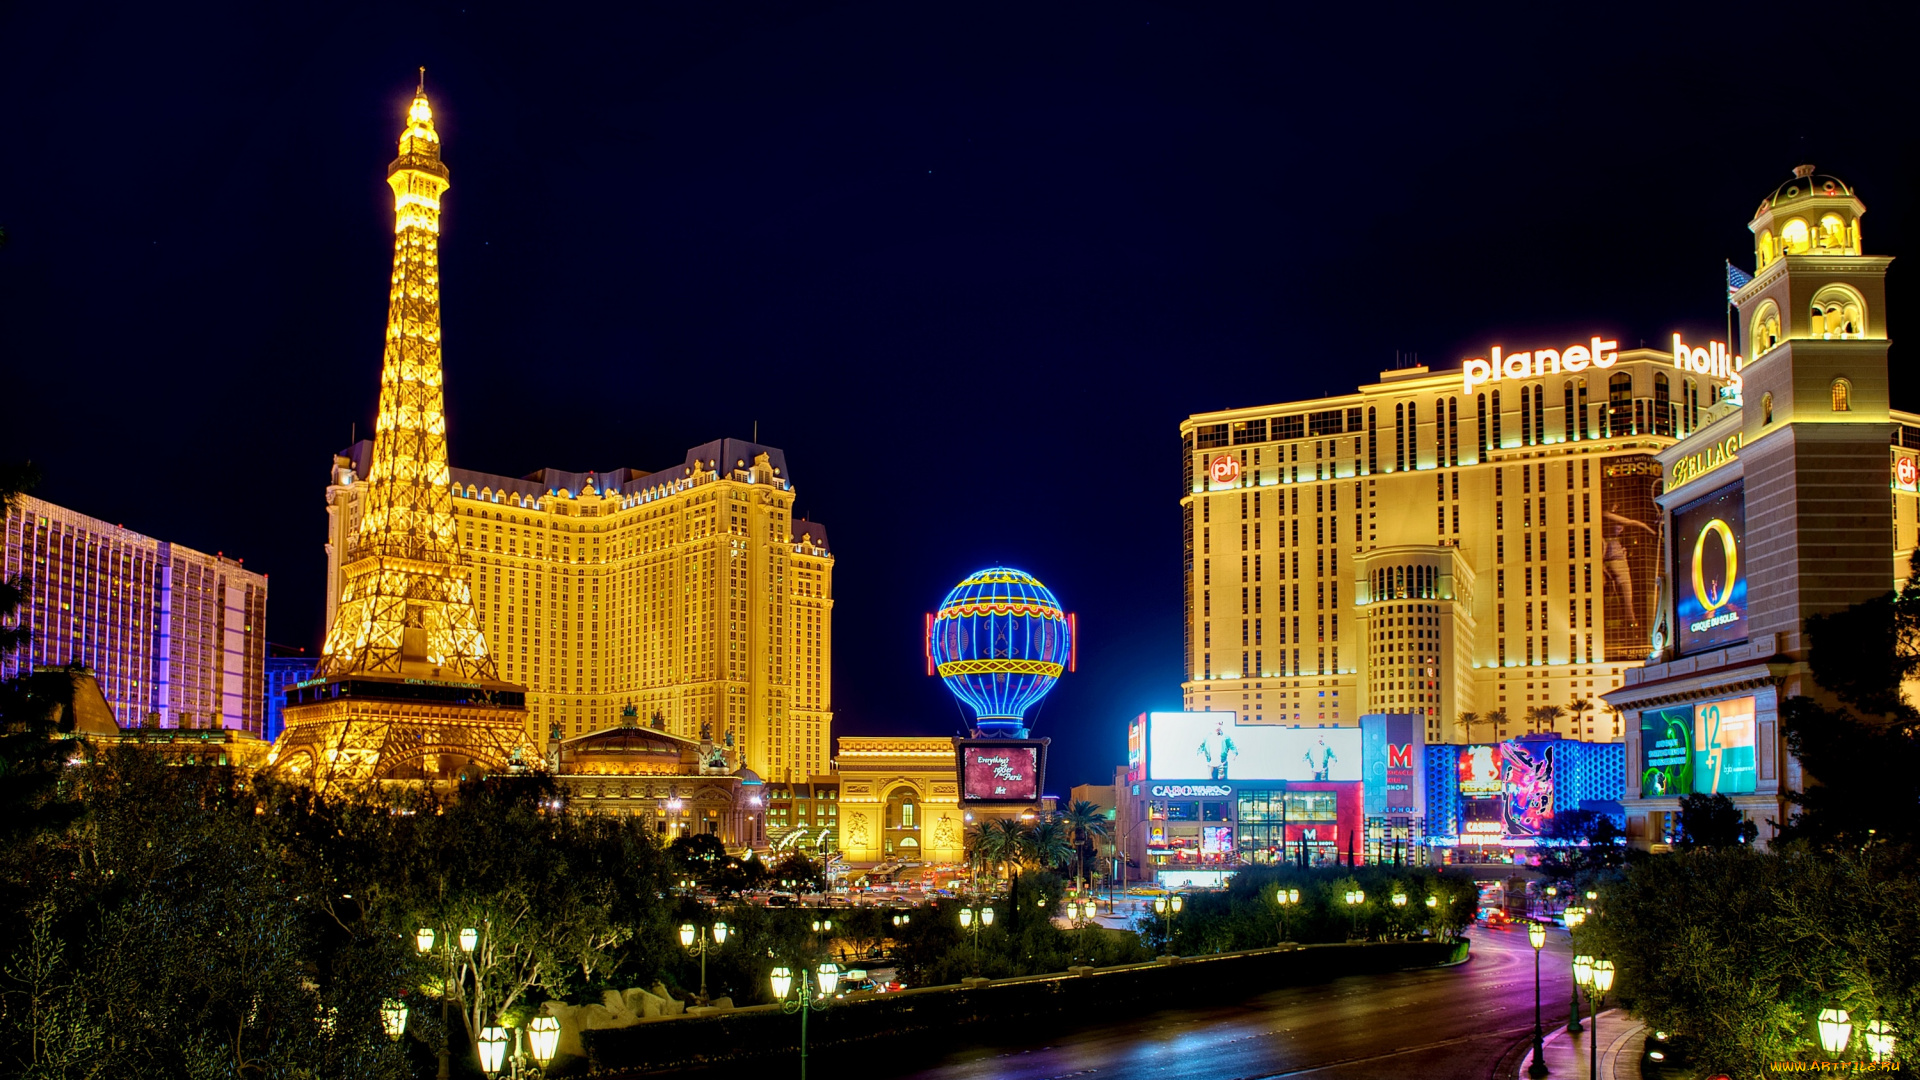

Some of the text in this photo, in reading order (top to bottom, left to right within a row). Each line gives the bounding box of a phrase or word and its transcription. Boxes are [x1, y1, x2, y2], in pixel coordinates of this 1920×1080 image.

[1463, 336, 1618, 394] planet
[1214, 456, 1239, 480] ph
[1691, 612, 1739, 632] CIRQUE DU SOLEIL
[1701, 705, 1722, 751] 12
[1387, 744, 1413, 768] M
[1151, 785, 1193, 798] CABO
[1304, 829, 1316, 840] M
[1466, 822, 1501, 833] CASINO
